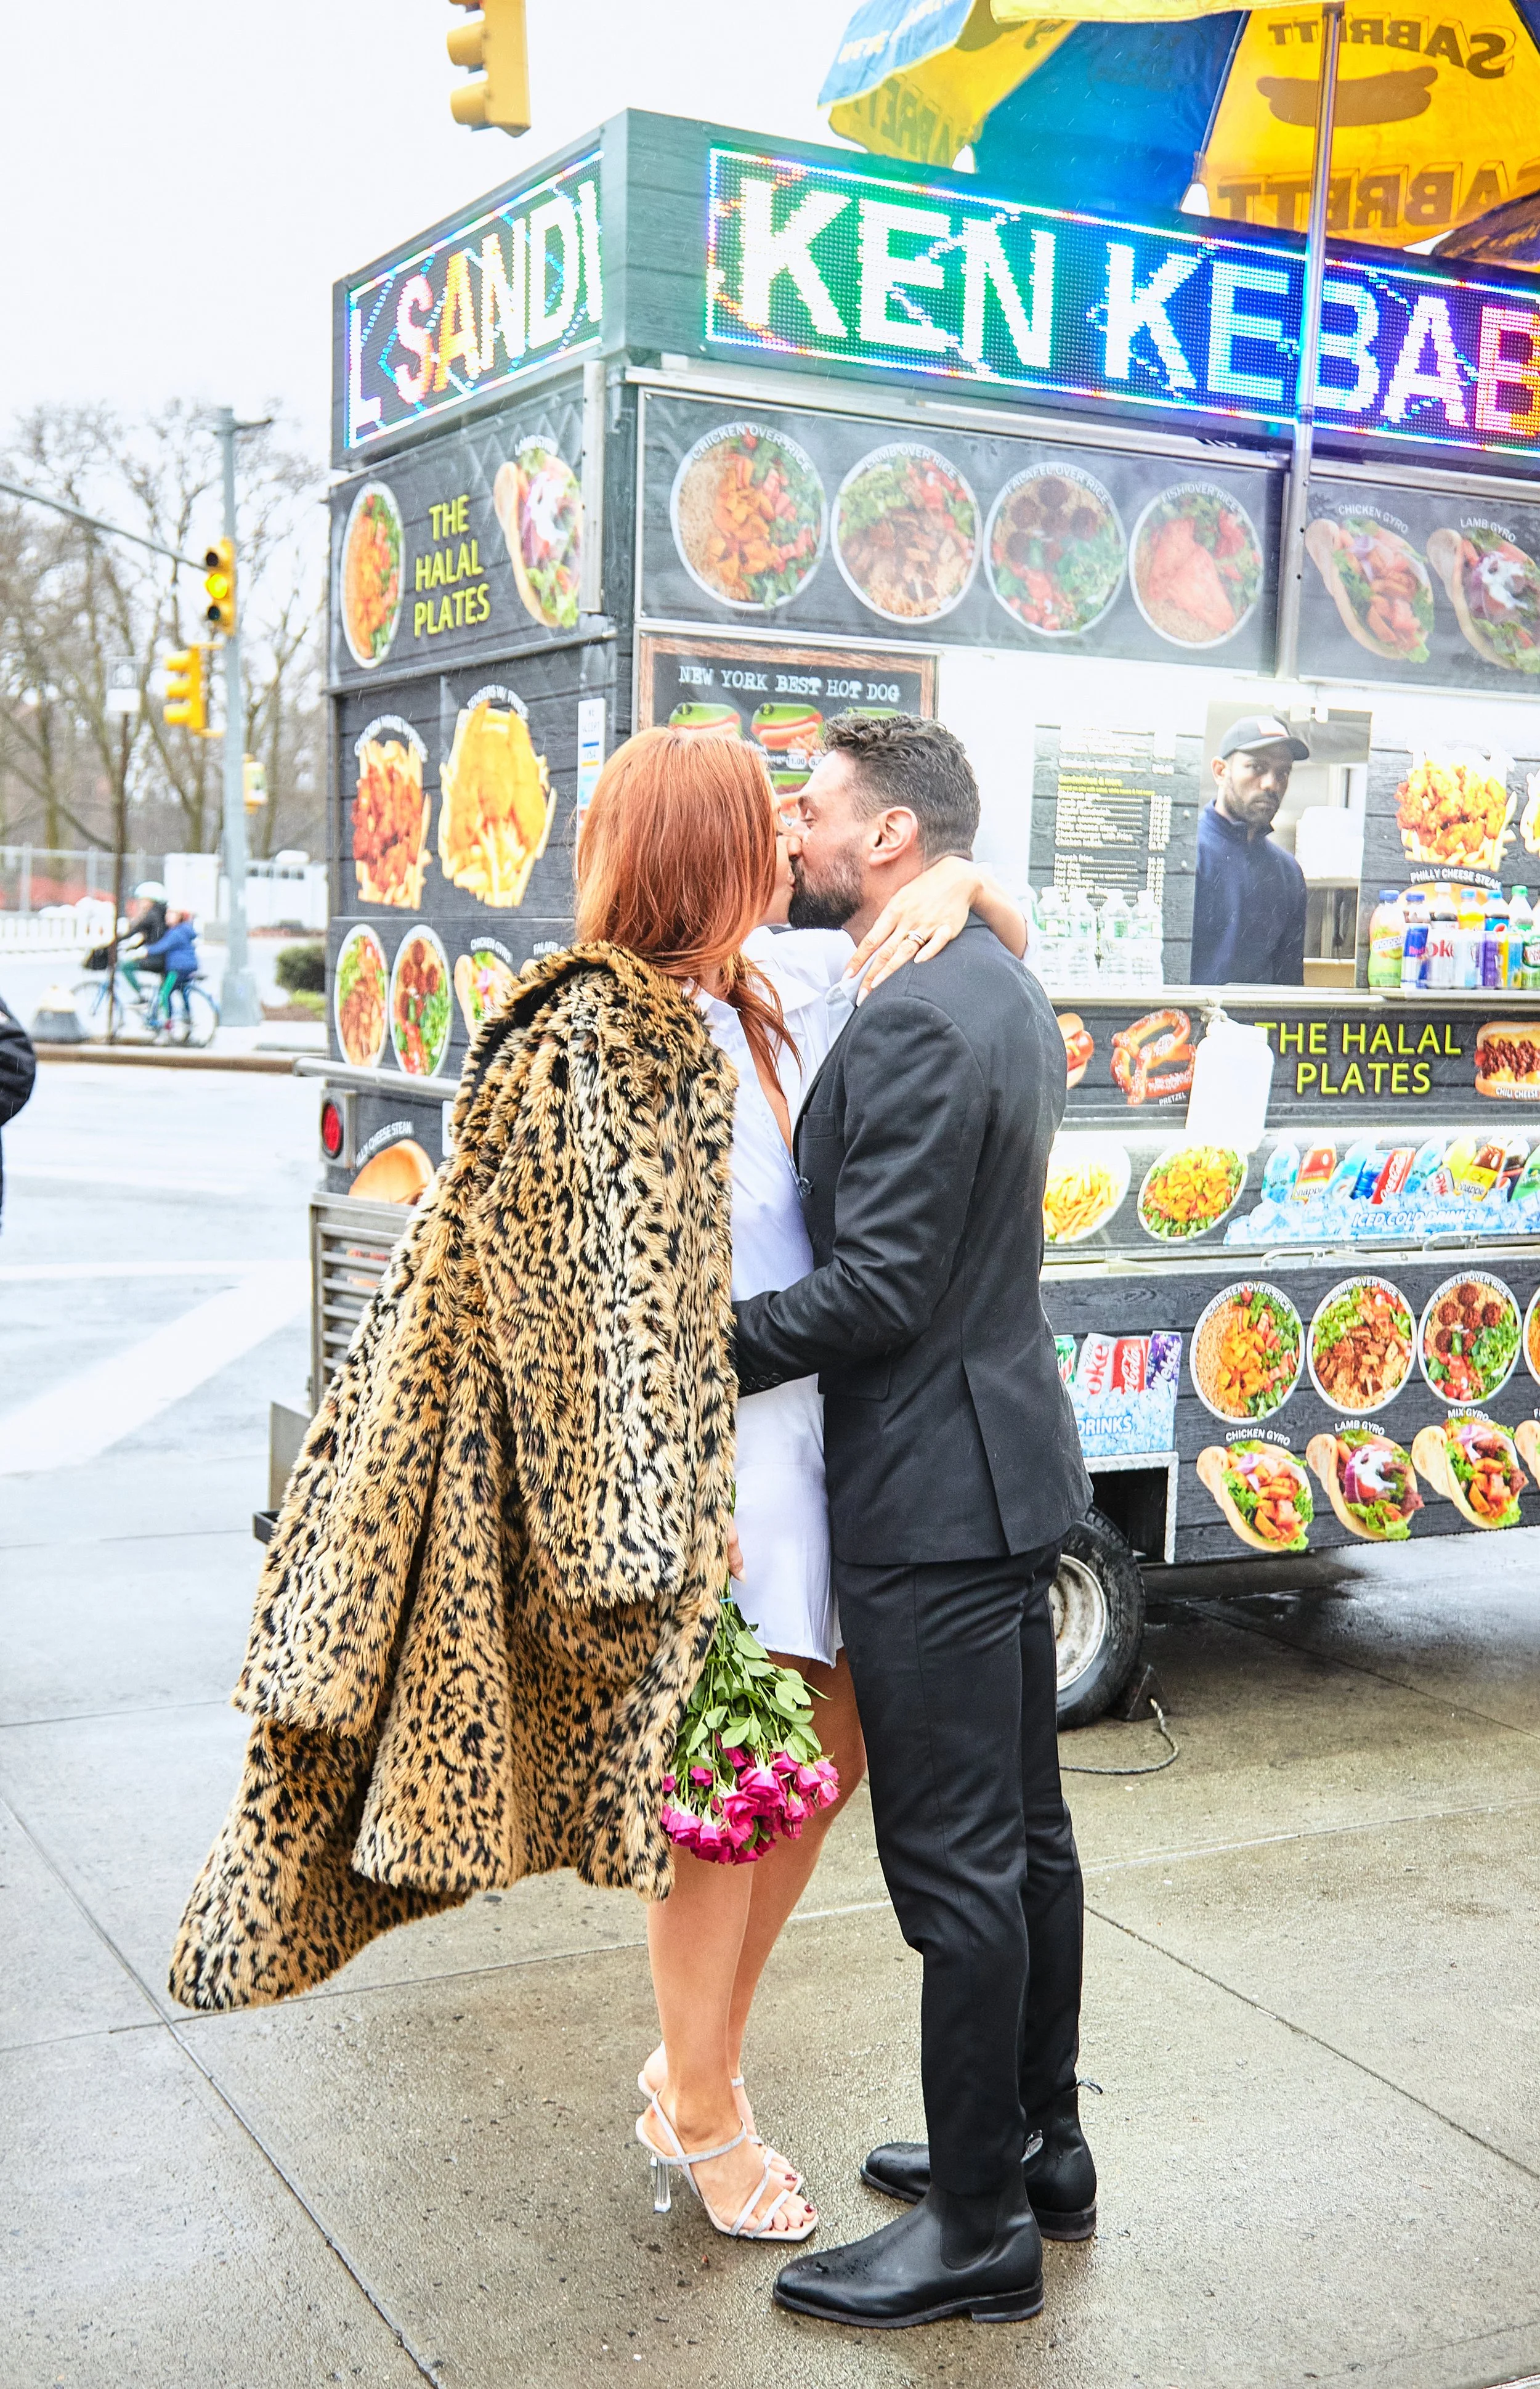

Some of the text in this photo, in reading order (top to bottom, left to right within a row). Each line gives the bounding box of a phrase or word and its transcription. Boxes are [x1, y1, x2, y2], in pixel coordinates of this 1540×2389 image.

[739, 177, 1540, 438] KEN KEBAB
[692, 424, 812, 473] CHICKEN OVER RICE
[863, 446, 958, 479] LAMB OVER RICE
[1004, 465, 1109, 505] FALAFEL OVER RICE
[1161, 484, 1238, 512] FISH OVER RICE
[429, 494, 471, 542] THE
[1338, 504, 1409, 534] CHICKEN GYRO
[1460, 518, 1517, 542] LAMB GYRO
[415, 538, 484, 592] HALAL
[414, 583, 491, 638] PLATES
[678, 665, 900, 702] NEW YORK BEST HOT DOG
[1410, 868, 1502, 890] PHILLY CHEESE STEAK
[471, 937, 514, 963] CHICKEN GYRO
[533, 940, 559, 956] FALAFEL
[1342, 1022, 1462, 1055] HALAL
[1295, 1062, 1431, 1094] PLATES
[1496, 1086, 1514, 1099] CHILI
[1159, 1091, 1186, 1107] PRETZEL
[368, 1124, 392, 1150] CHEESE
[1352, 1210, 1477, 1227] ICED COLD DRINKS
[1206, 1282, 1292, 1317] CHICKEN OVER RICE
[1329, 1277, 1398, 1302] LAMB OVER RICE
[1433, 1272, 1509, 1303] FALAFEL OVER RICE
[1084, 1344, 1109, 1396] oke
[1078, 1416, 1133, 1437] DRINKS
[1334, 1420, 1385, 1436] LAMB GYRO
[1447, 1407, 1489, 1422] MIX GYRO
[1225, 1428, 1291, 1446] CHICKEN GYRO
